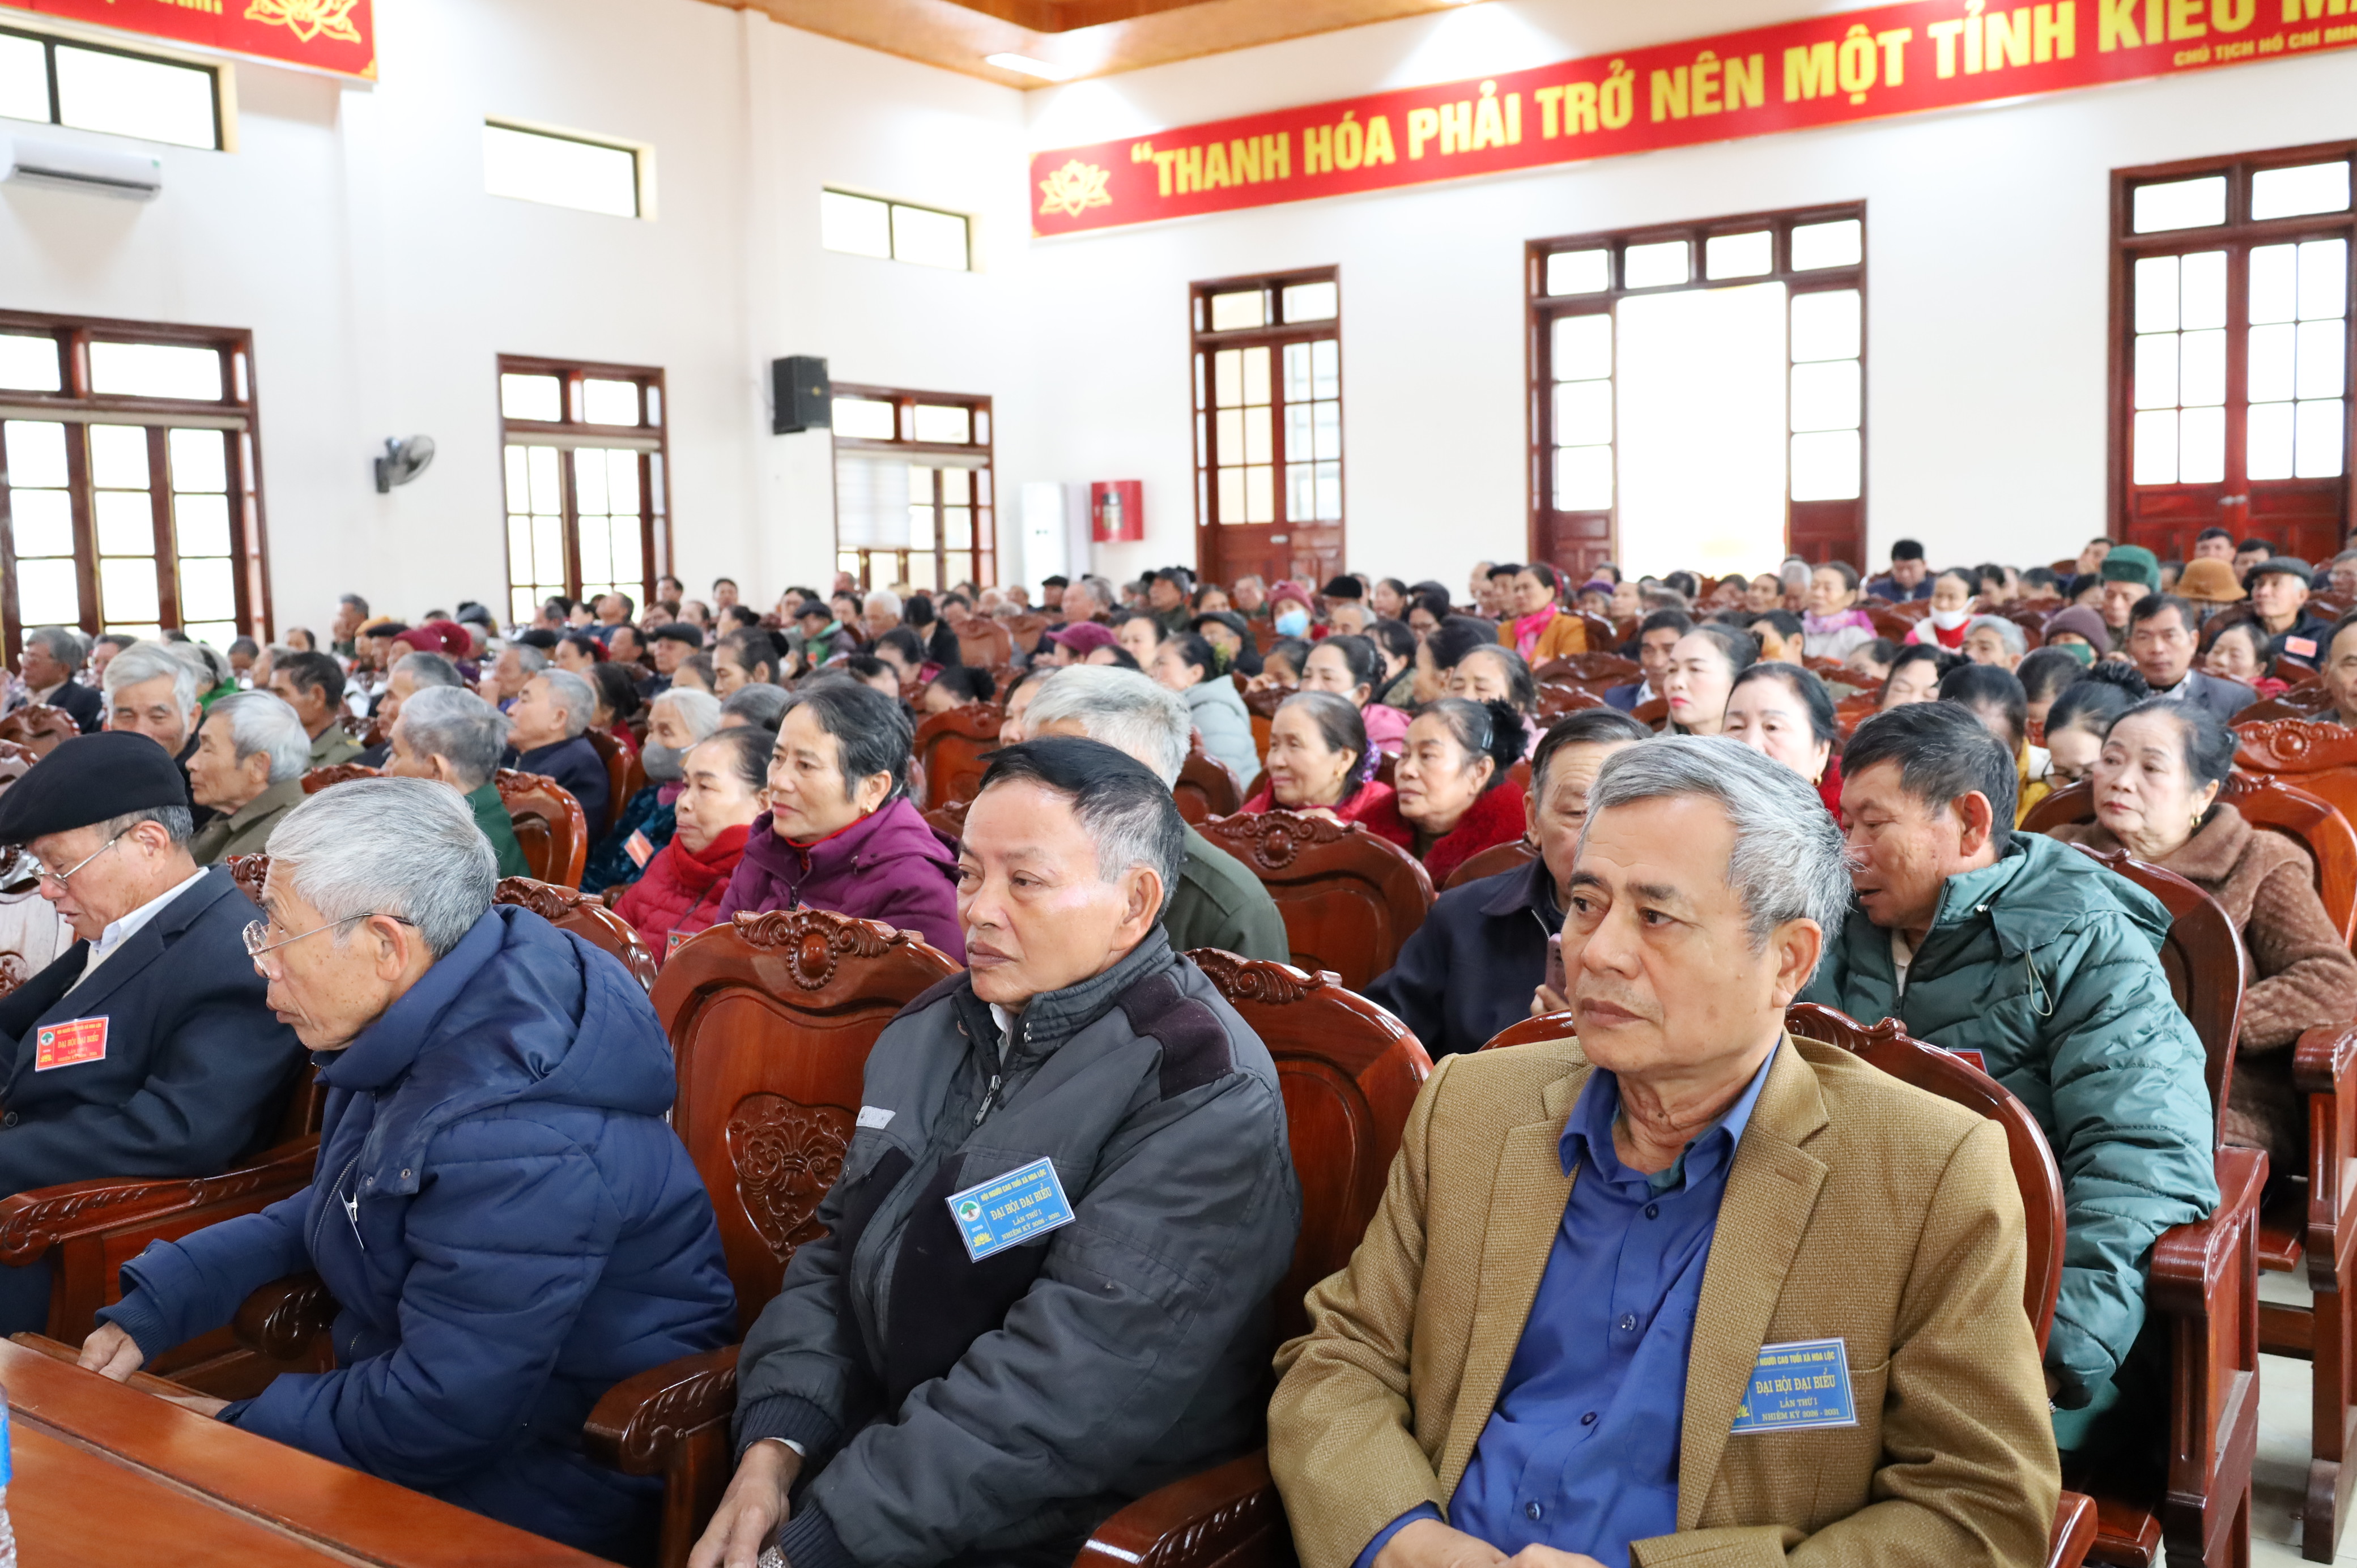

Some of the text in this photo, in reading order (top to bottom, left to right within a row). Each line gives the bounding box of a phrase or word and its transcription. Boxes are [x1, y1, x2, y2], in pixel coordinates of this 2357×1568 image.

[1303, 110, 1396, 175] HÓA
[1407, 79, 1522, 161] PHẢI
[1534, 59, 1637, 139] TRỞ
[1650, 51, 1764, 122] NÊN
[1783, 24, 1913, 105] MỘT
[1927, 0, 2075, 80] TỈNH
[980, 1191, 989, 1201] HỘI
[1002, 1183, 1012, 1192] CAO
[1011, 1177, 1023, 1188] TUỔI
[1028, 1173, 1038, 1181] HOA
[1037, 1169, 1047, 1178] LỘC
[990, 1183, 1052, 1221] ĐẠI HỘI ĐẠI BIỂU
[1026, 1209, 1039, 1220] THỨ
[1001, 1227, 1022, 1241] NHIỆM
[1022, 1222, 1032, 1232] KỲ
[1032, 1218, 1045, 1228] 2026
[1759, 1354, 1777, 1366] NGƯỜI
[1777, 1355, 1789, 1365] CAO
[1790, 1351, 1802, 1364] TUỔI
[1811, 1352, 1823, 1361] HOA
[1824, 1350, 1835, 1362] LỘC
[1755, 1367, 1836, 1396] ĐẠI HỘI ĐẠI BIỂU
[1797, 1395, 1813, 1407] THỨ
[1762, 1410, 1788, 1421] NHIỆM
[1789, 1408, 1801, 1419] KỲ
